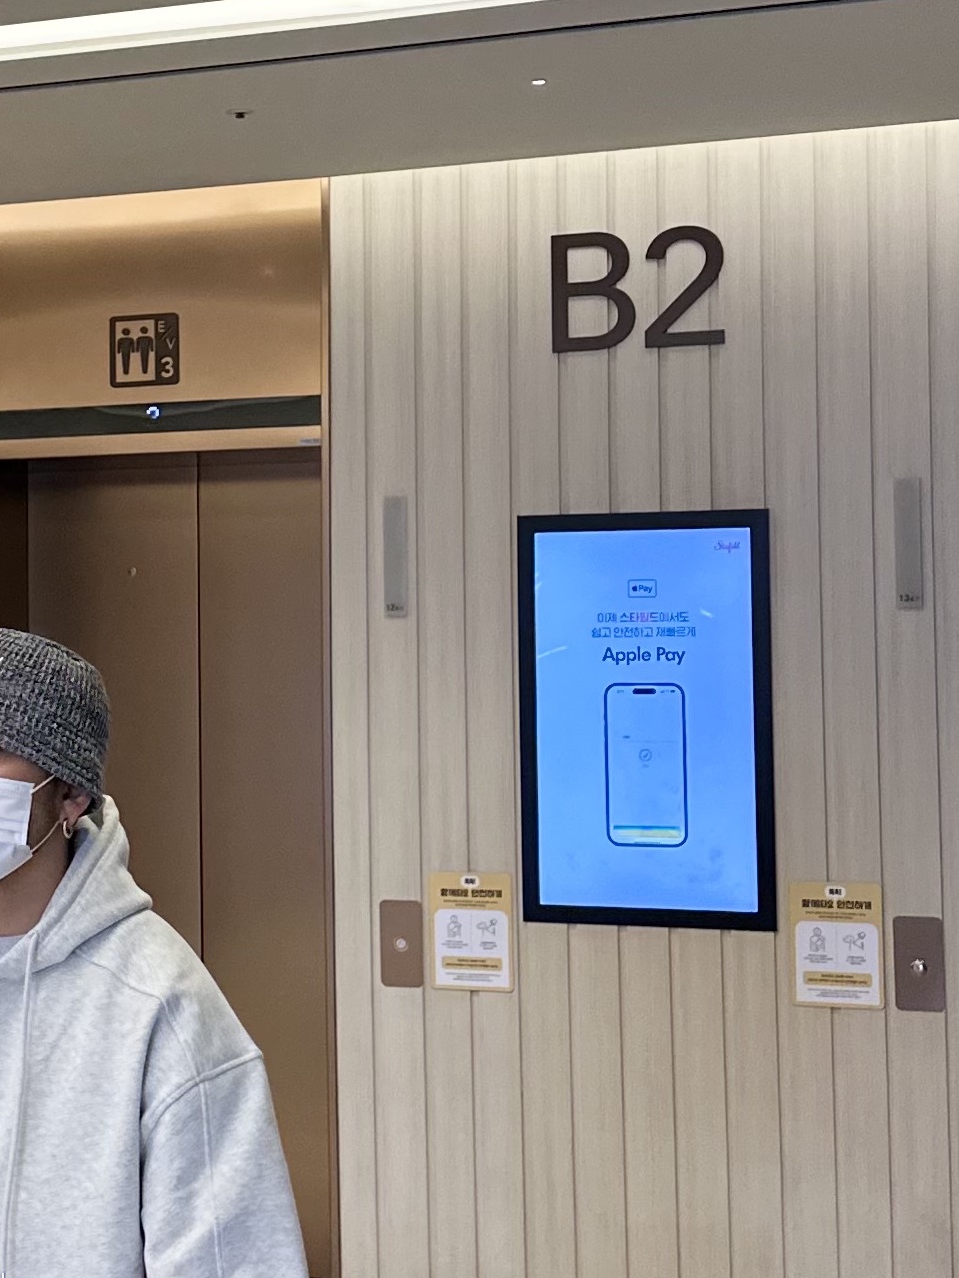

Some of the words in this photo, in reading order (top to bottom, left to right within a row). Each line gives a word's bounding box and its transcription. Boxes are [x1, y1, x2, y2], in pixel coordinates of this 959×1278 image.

[551, 225, 725, 353] B2
[160, 356, 174, 378] 3
[597, 612, 617, 623] 이제
[591, 626, 612, 638] 쉽고
[613, 626, 653, 638] 안전하고
[602, 646, 652, 665] Apple
[656, 646, 686, 665] Pay
